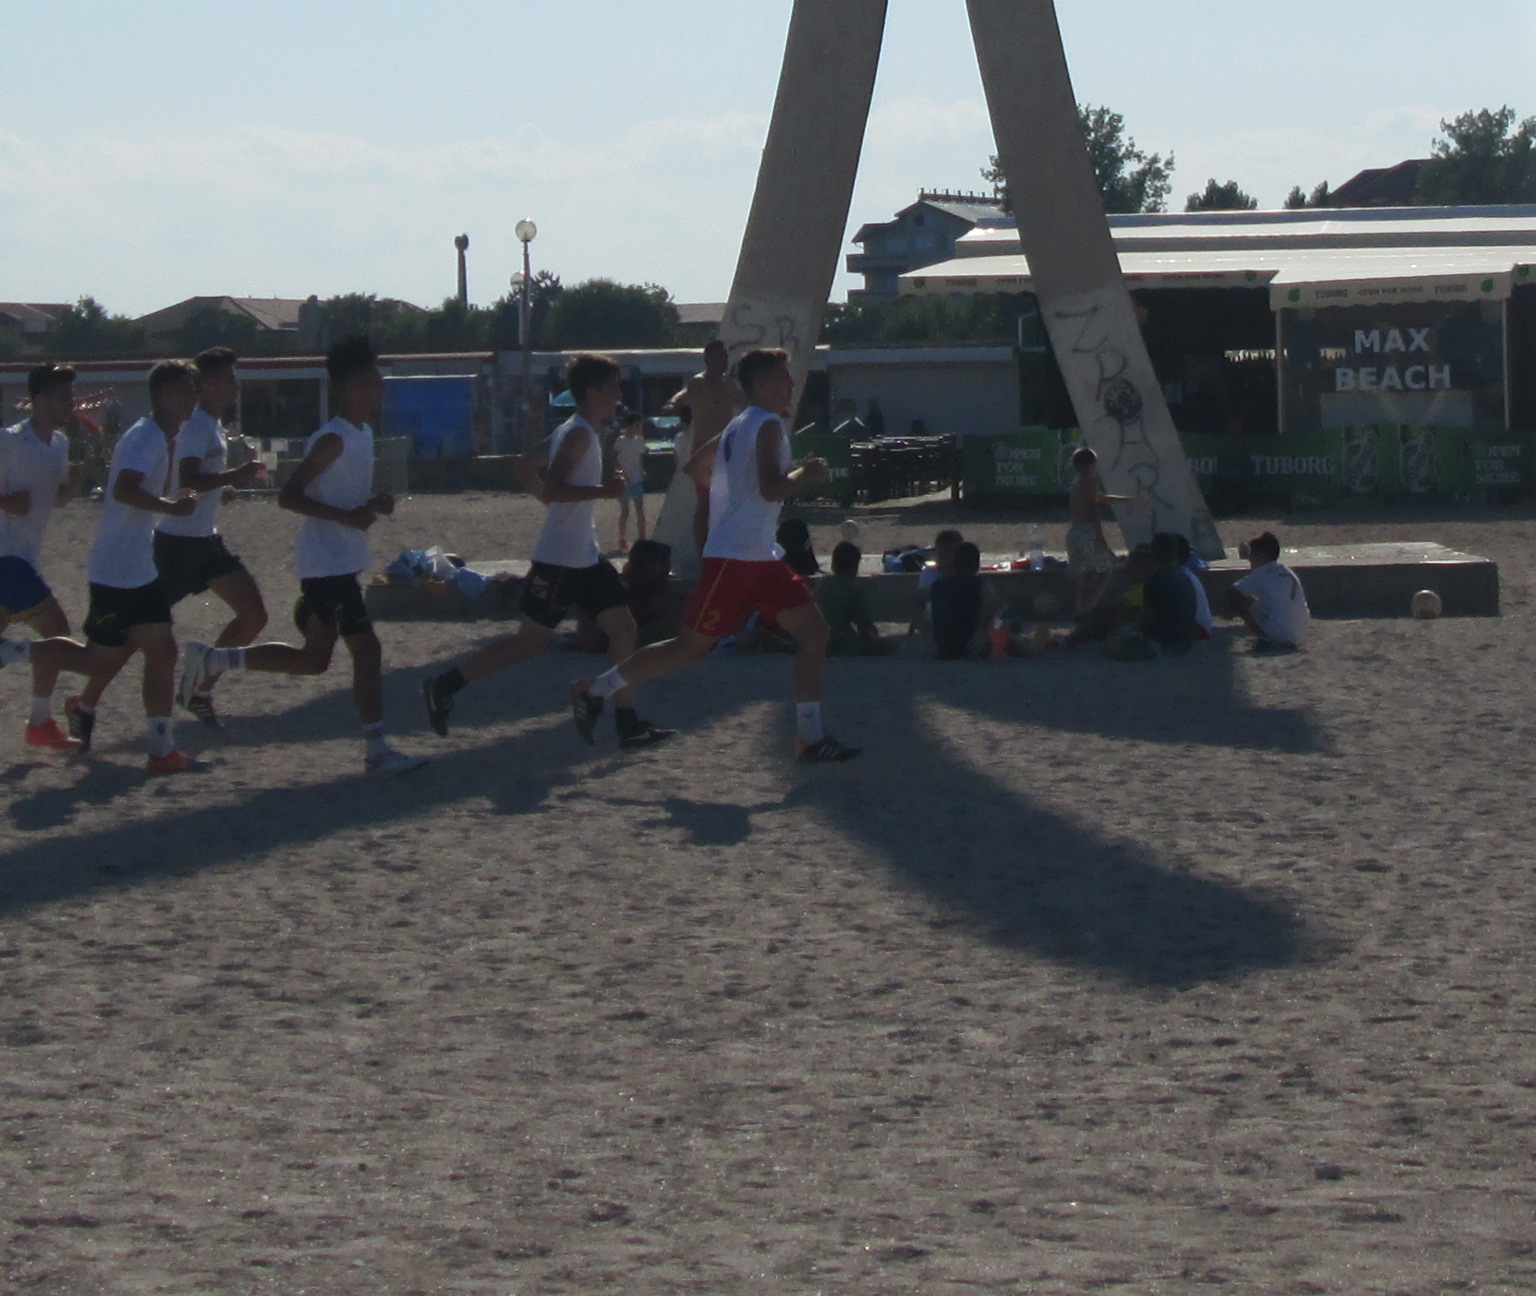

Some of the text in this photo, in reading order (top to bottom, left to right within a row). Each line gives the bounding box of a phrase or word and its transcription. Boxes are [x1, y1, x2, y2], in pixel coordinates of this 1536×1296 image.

[1354, 327, 1431, 354] MAX
[1335, 364, 1451, 392] BEACH
[1250, 454, 1338, 476] TUBORG
[702, 609, 721, 631] 2
